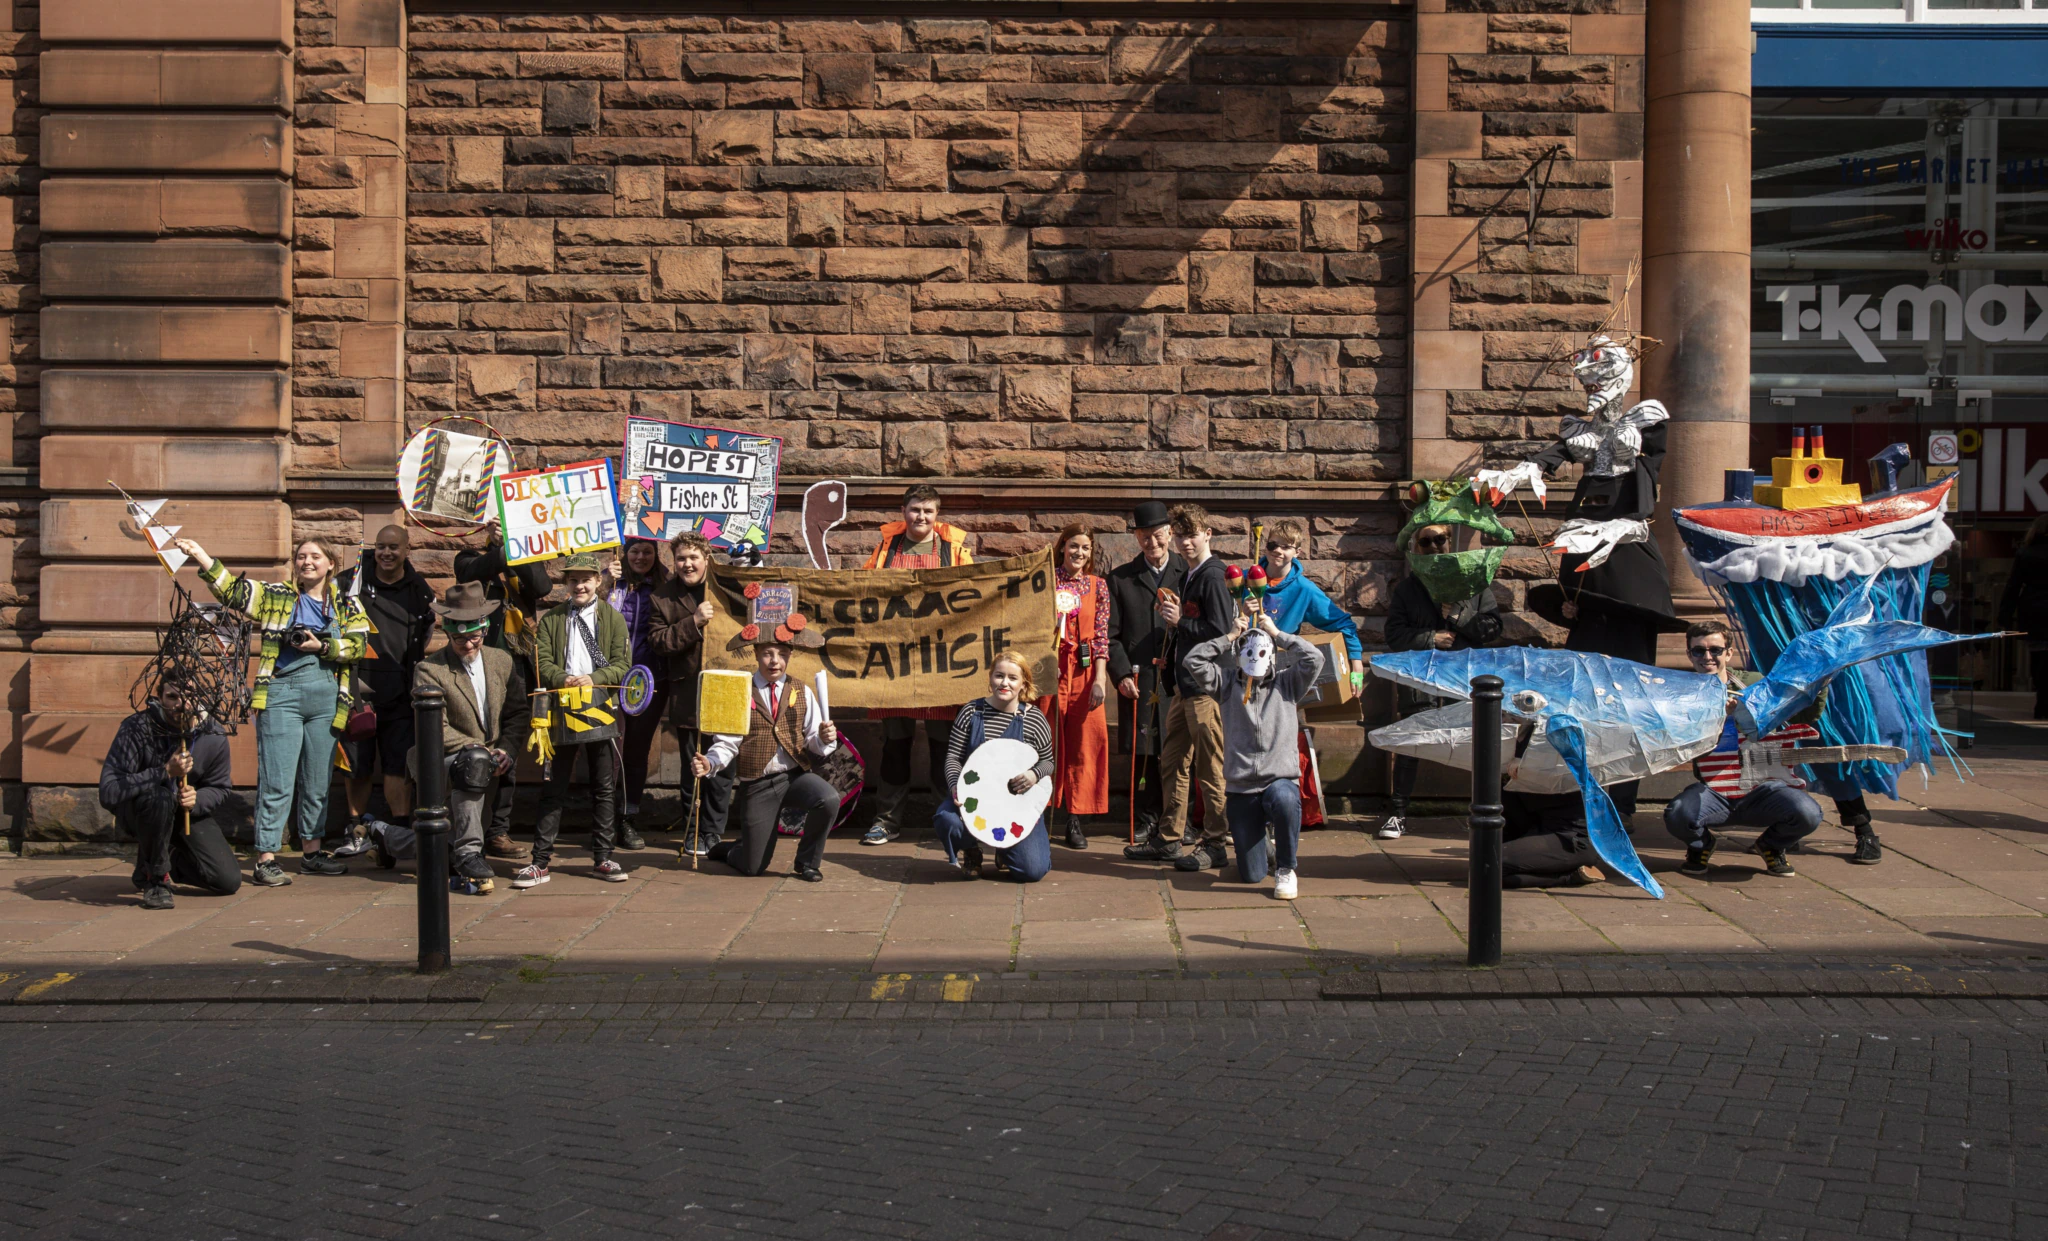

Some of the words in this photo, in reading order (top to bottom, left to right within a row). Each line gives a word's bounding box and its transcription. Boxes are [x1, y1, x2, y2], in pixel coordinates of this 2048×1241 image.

[1839, 158, 1880, 184] THE
[1897, 158, 1991, 184] MARKET
[1904, 218, 1988, 250] wilko
[649, 445, 720, 473] HOPE
[725, 454, 749, 474] ST
[501, 467, 607, 502] DIRITTI
[669, 485, 717, 511] Fisher
[721, 485, 738, 510] St
[531, 496, 582, 524] GAY
[1761, 513, 1805, 532] HMS
[505, 519, 616, 560] OVUNIQUE
